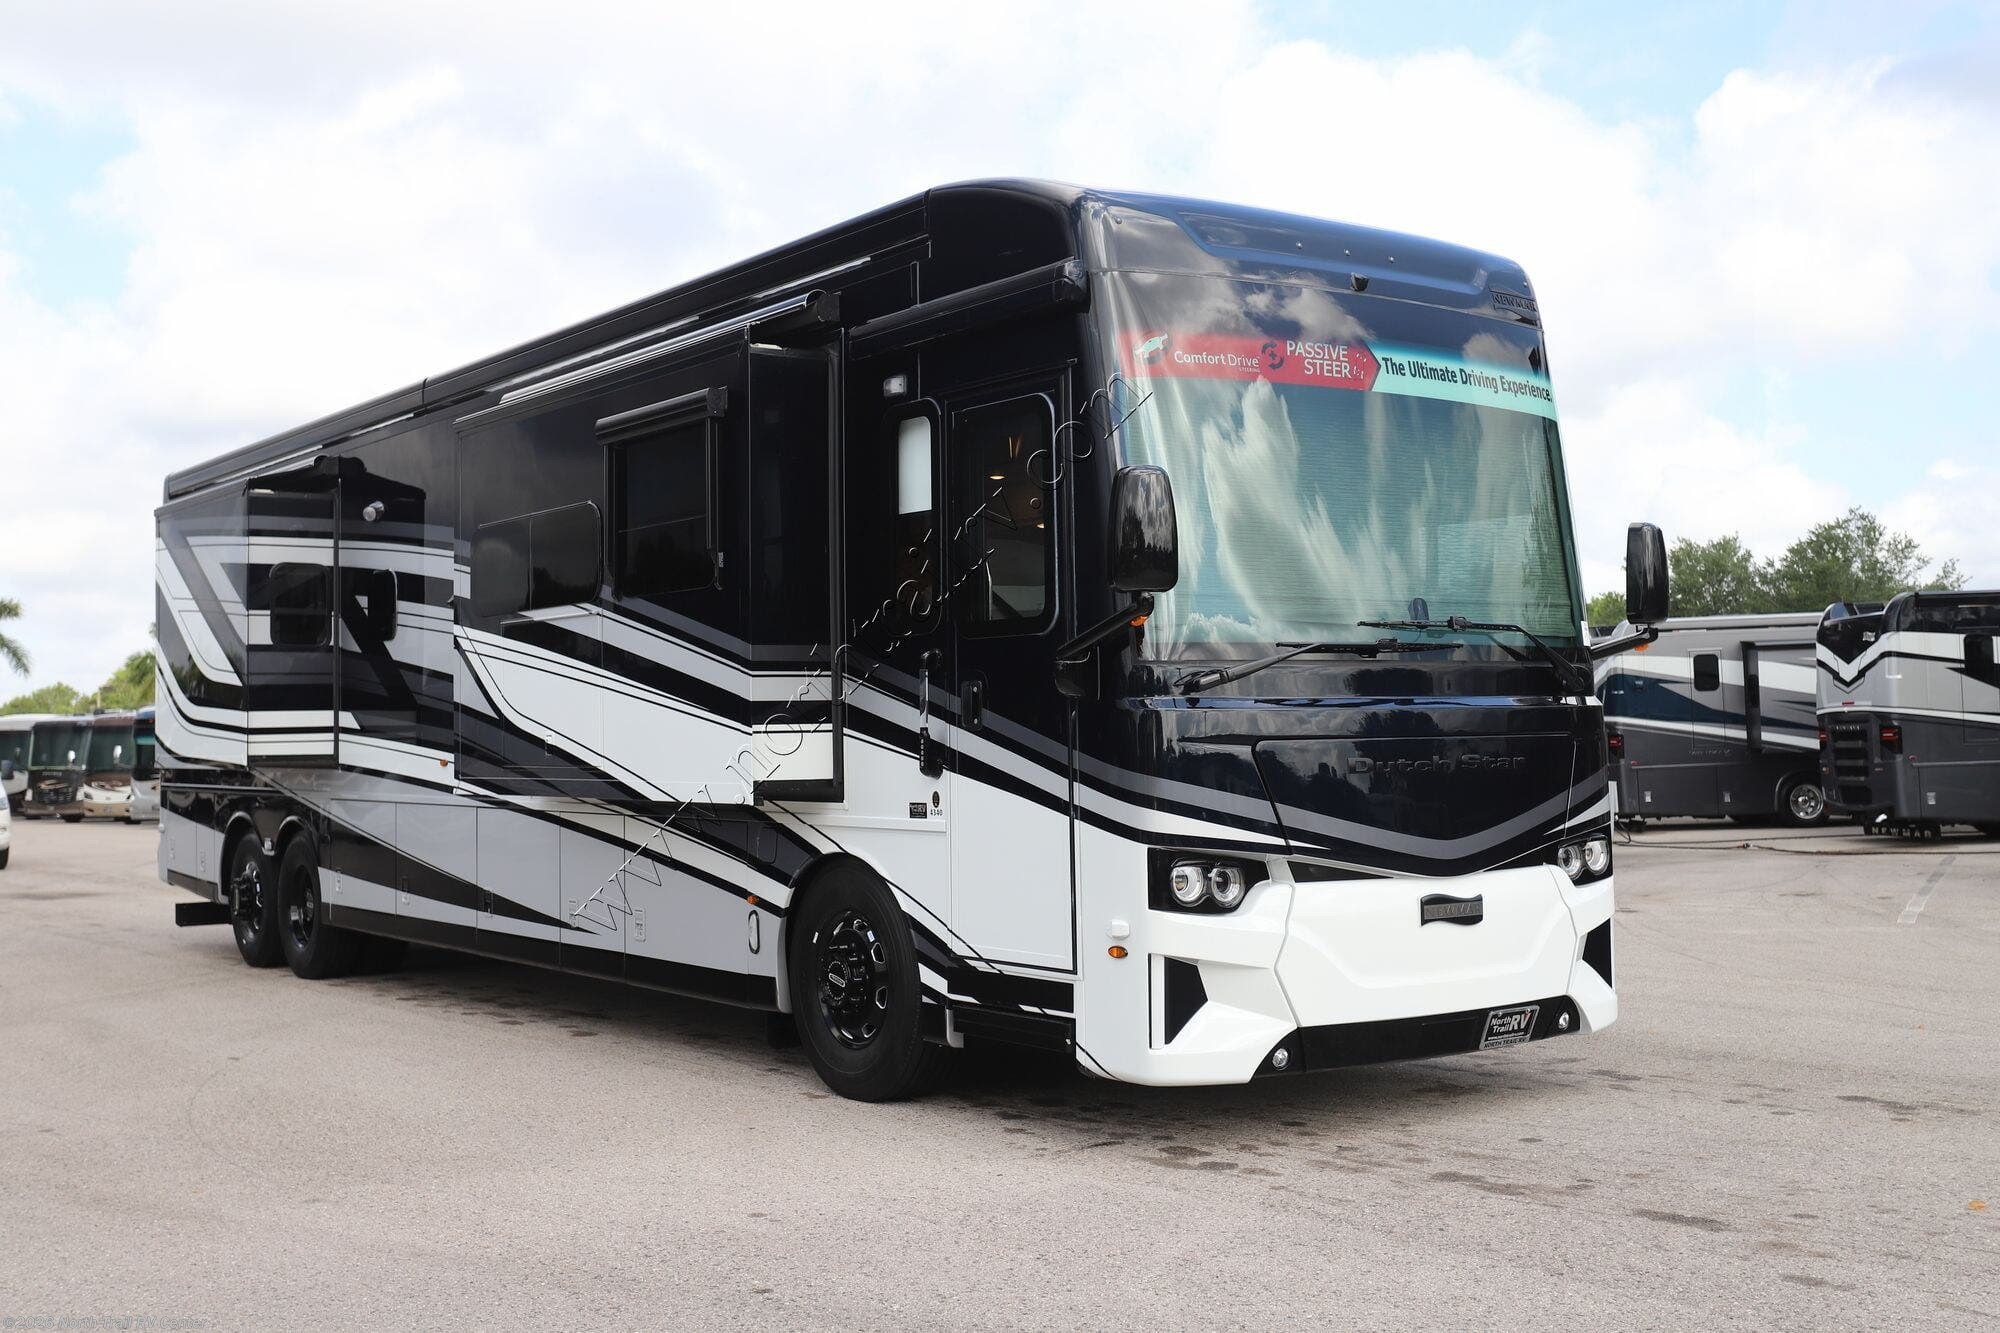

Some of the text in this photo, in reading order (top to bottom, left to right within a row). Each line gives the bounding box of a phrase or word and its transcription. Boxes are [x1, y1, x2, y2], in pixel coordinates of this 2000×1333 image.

[1286, 340, 1348, 361] PASSIVE
[1304, 359, 1352, 379] STEER
[1382, 357, 1405, 376] The
[1408, 360, 1458, 383] Ultimate
[1460, 369, 1499, 393] Driving
[1347, 754, 1525, 776] Dutch Star
[1490, 1013, 1531, 1031] North RV
[1493, 1024, 1510, 1033] Trail
